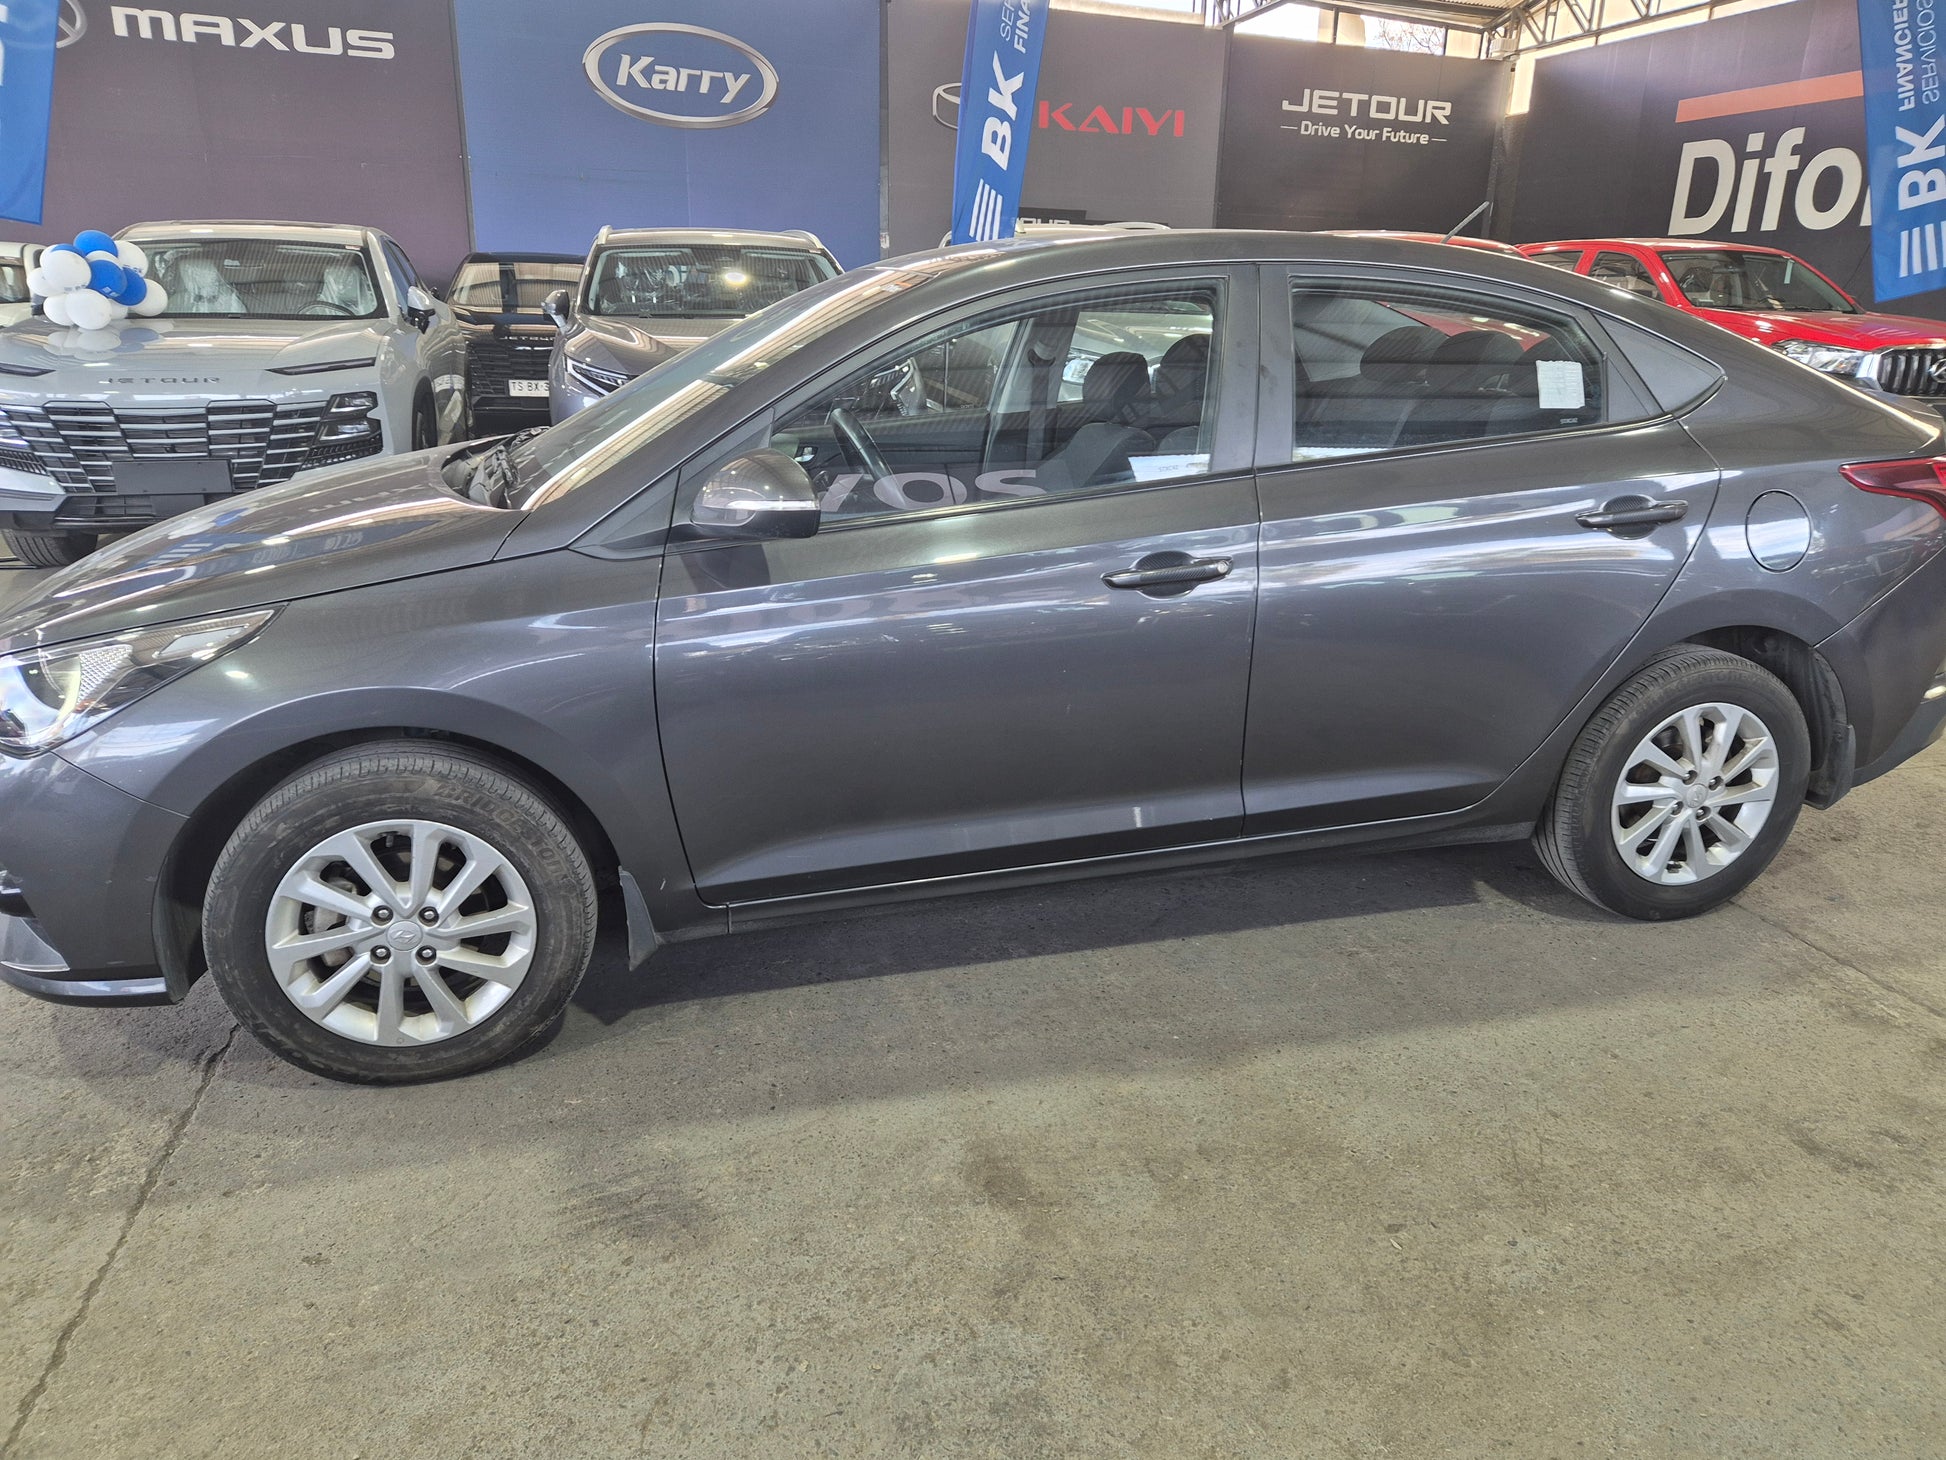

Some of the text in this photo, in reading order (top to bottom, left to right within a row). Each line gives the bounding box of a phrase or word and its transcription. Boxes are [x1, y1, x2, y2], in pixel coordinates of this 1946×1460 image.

[110, 6, 395, 60] MAXUS
[616, 53, 751, 104] Karry
[981, 50, 1025, 171] BK
[1038, 100, 1185, 138] KAIYI
[1282, 88, 1452, 125] JETOUR
[1300, 120, 1430, 145] Drive Your Future
